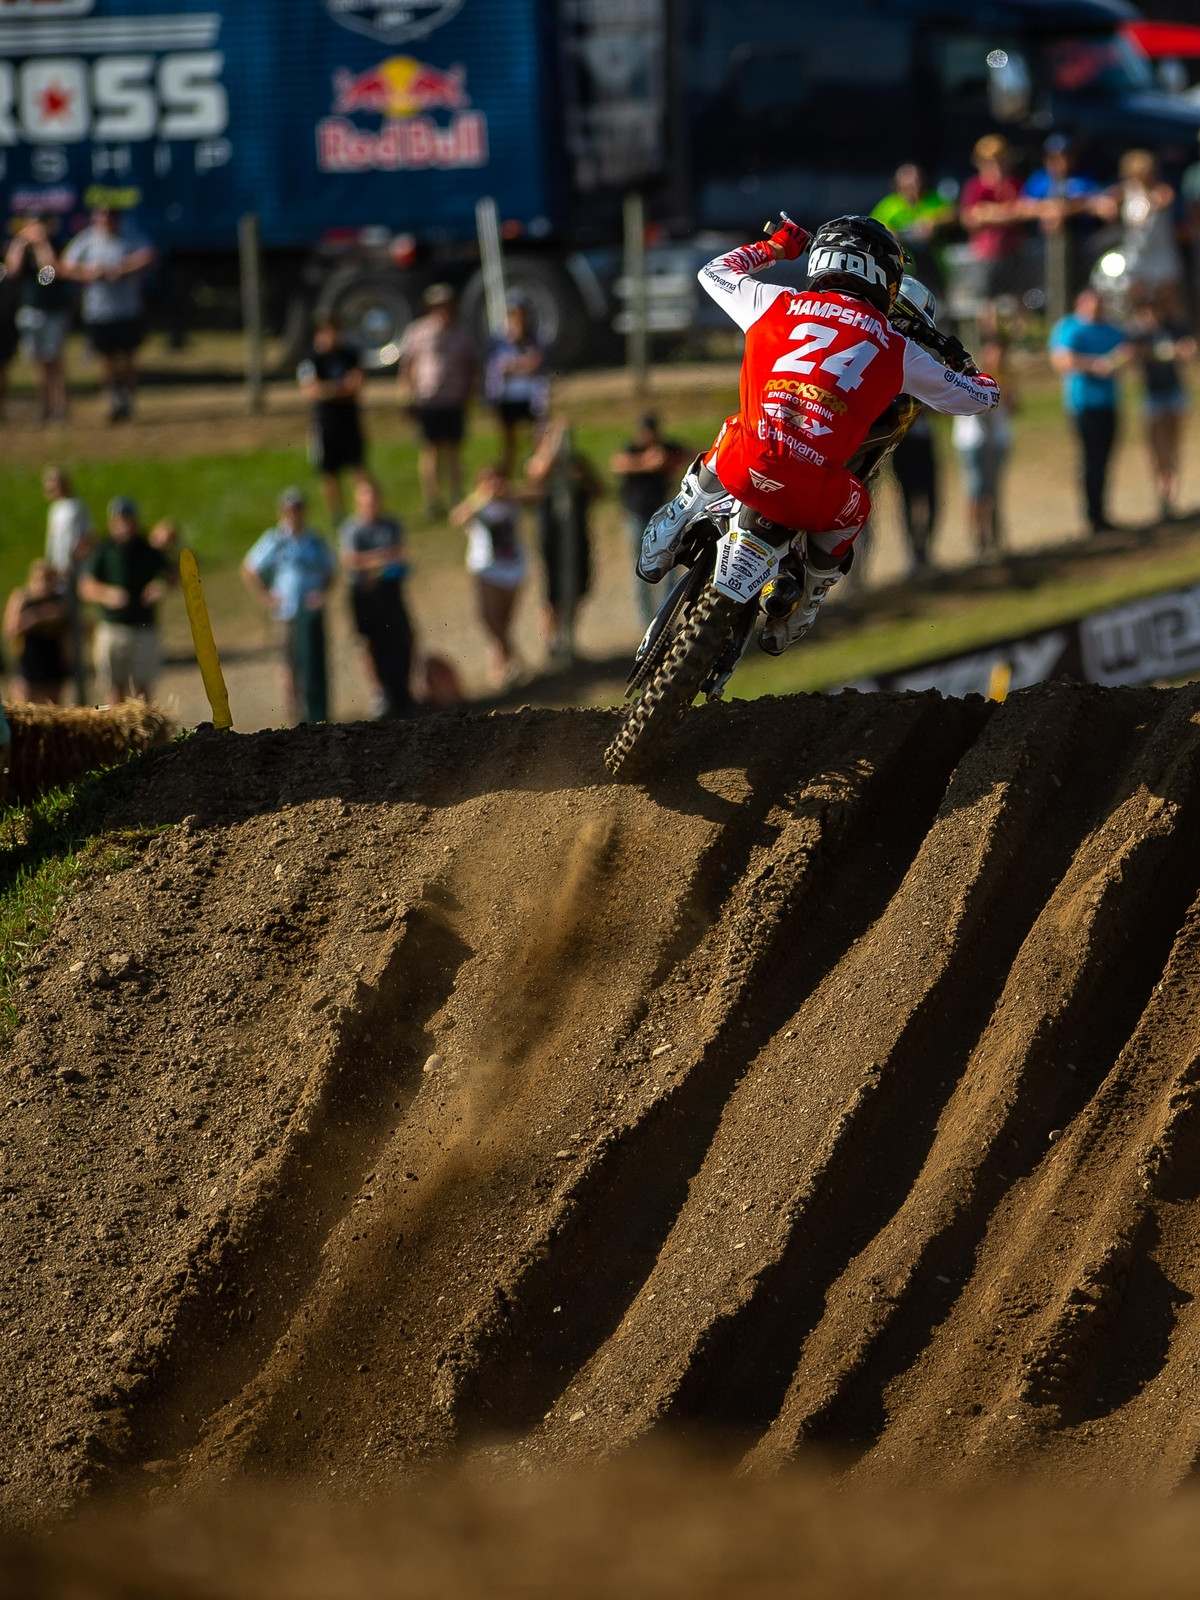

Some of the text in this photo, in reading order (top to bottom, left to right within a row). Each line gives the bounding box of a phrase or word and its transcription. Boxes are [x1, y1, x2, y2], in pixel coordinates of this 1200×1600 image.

[0, 51, 229, 145] OSS
[0, 138, 232, 183] SHIP
[316, 110, 489, 172] Red Bull
[786, 299, 889, 349] HAMPSHIRE
[771, 322, 880, 393] 24
[763, 378, 848, 416] ROCKSTAR
[767, 391, 834, 422] ENERGY DRINK
[766, 424, 825, 467] Husqvarna
[720, 544, 731, 577] DUNLOP
[747, 568, 772, 593] DUNLOP
